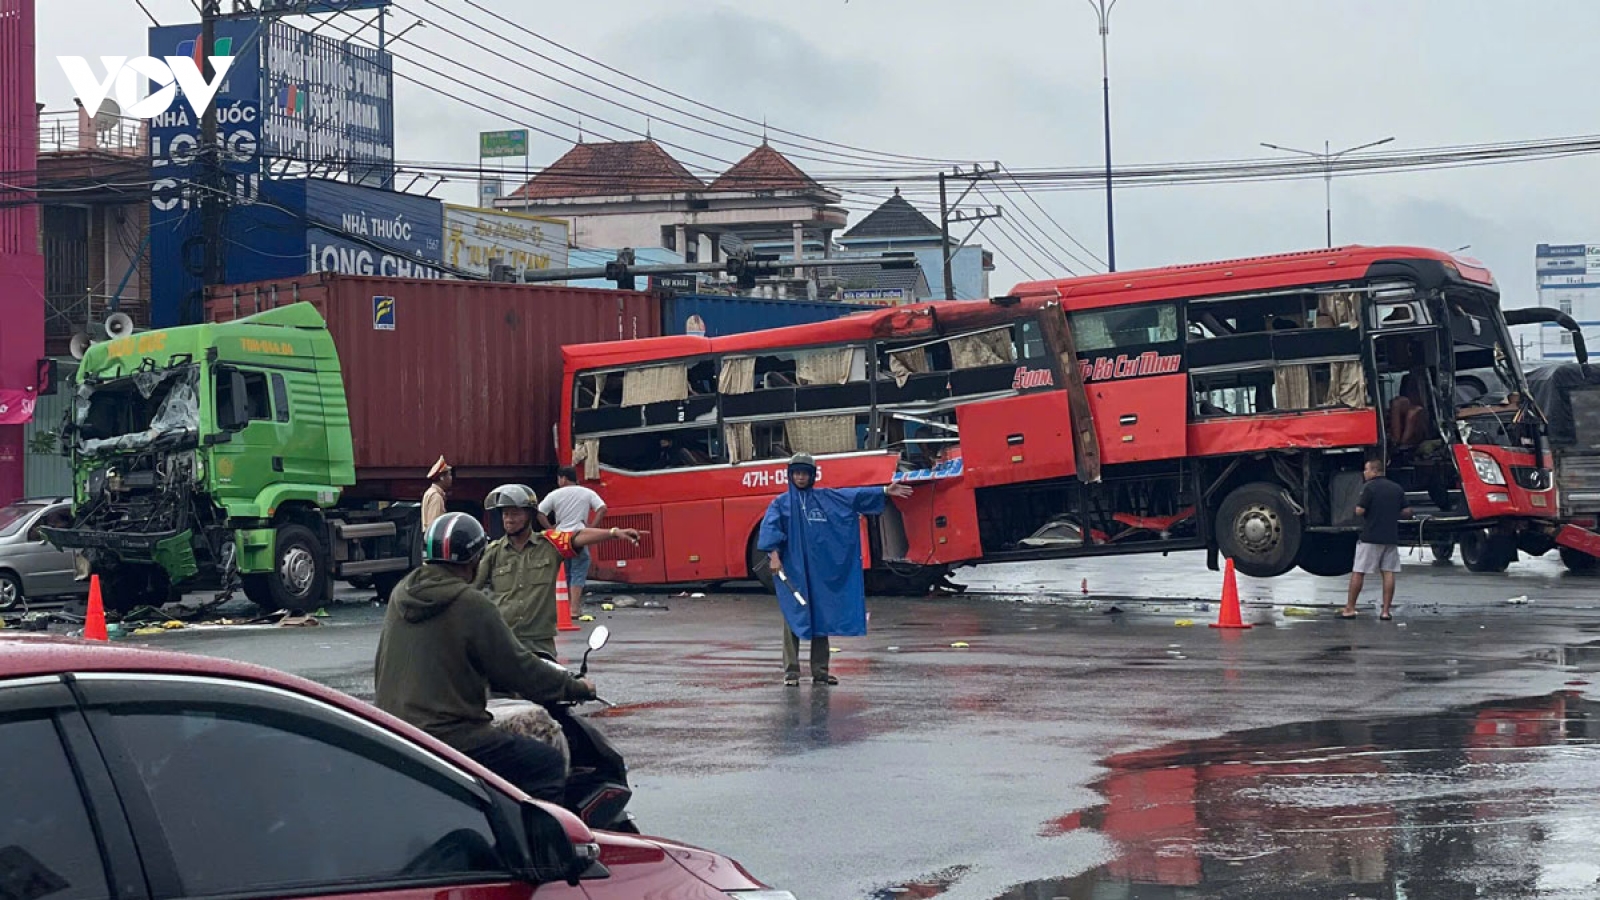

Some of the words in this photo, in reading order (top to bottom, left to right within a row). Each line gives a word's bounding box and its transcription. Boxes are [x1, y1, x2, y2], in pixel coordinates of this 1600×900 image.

[152, 105, 189, 128] NHÀ
[342, 211, 369, 236] NHÀ
[371, 213, 412, 241] THUỐC
[311, 244, 375, 276] LONG
